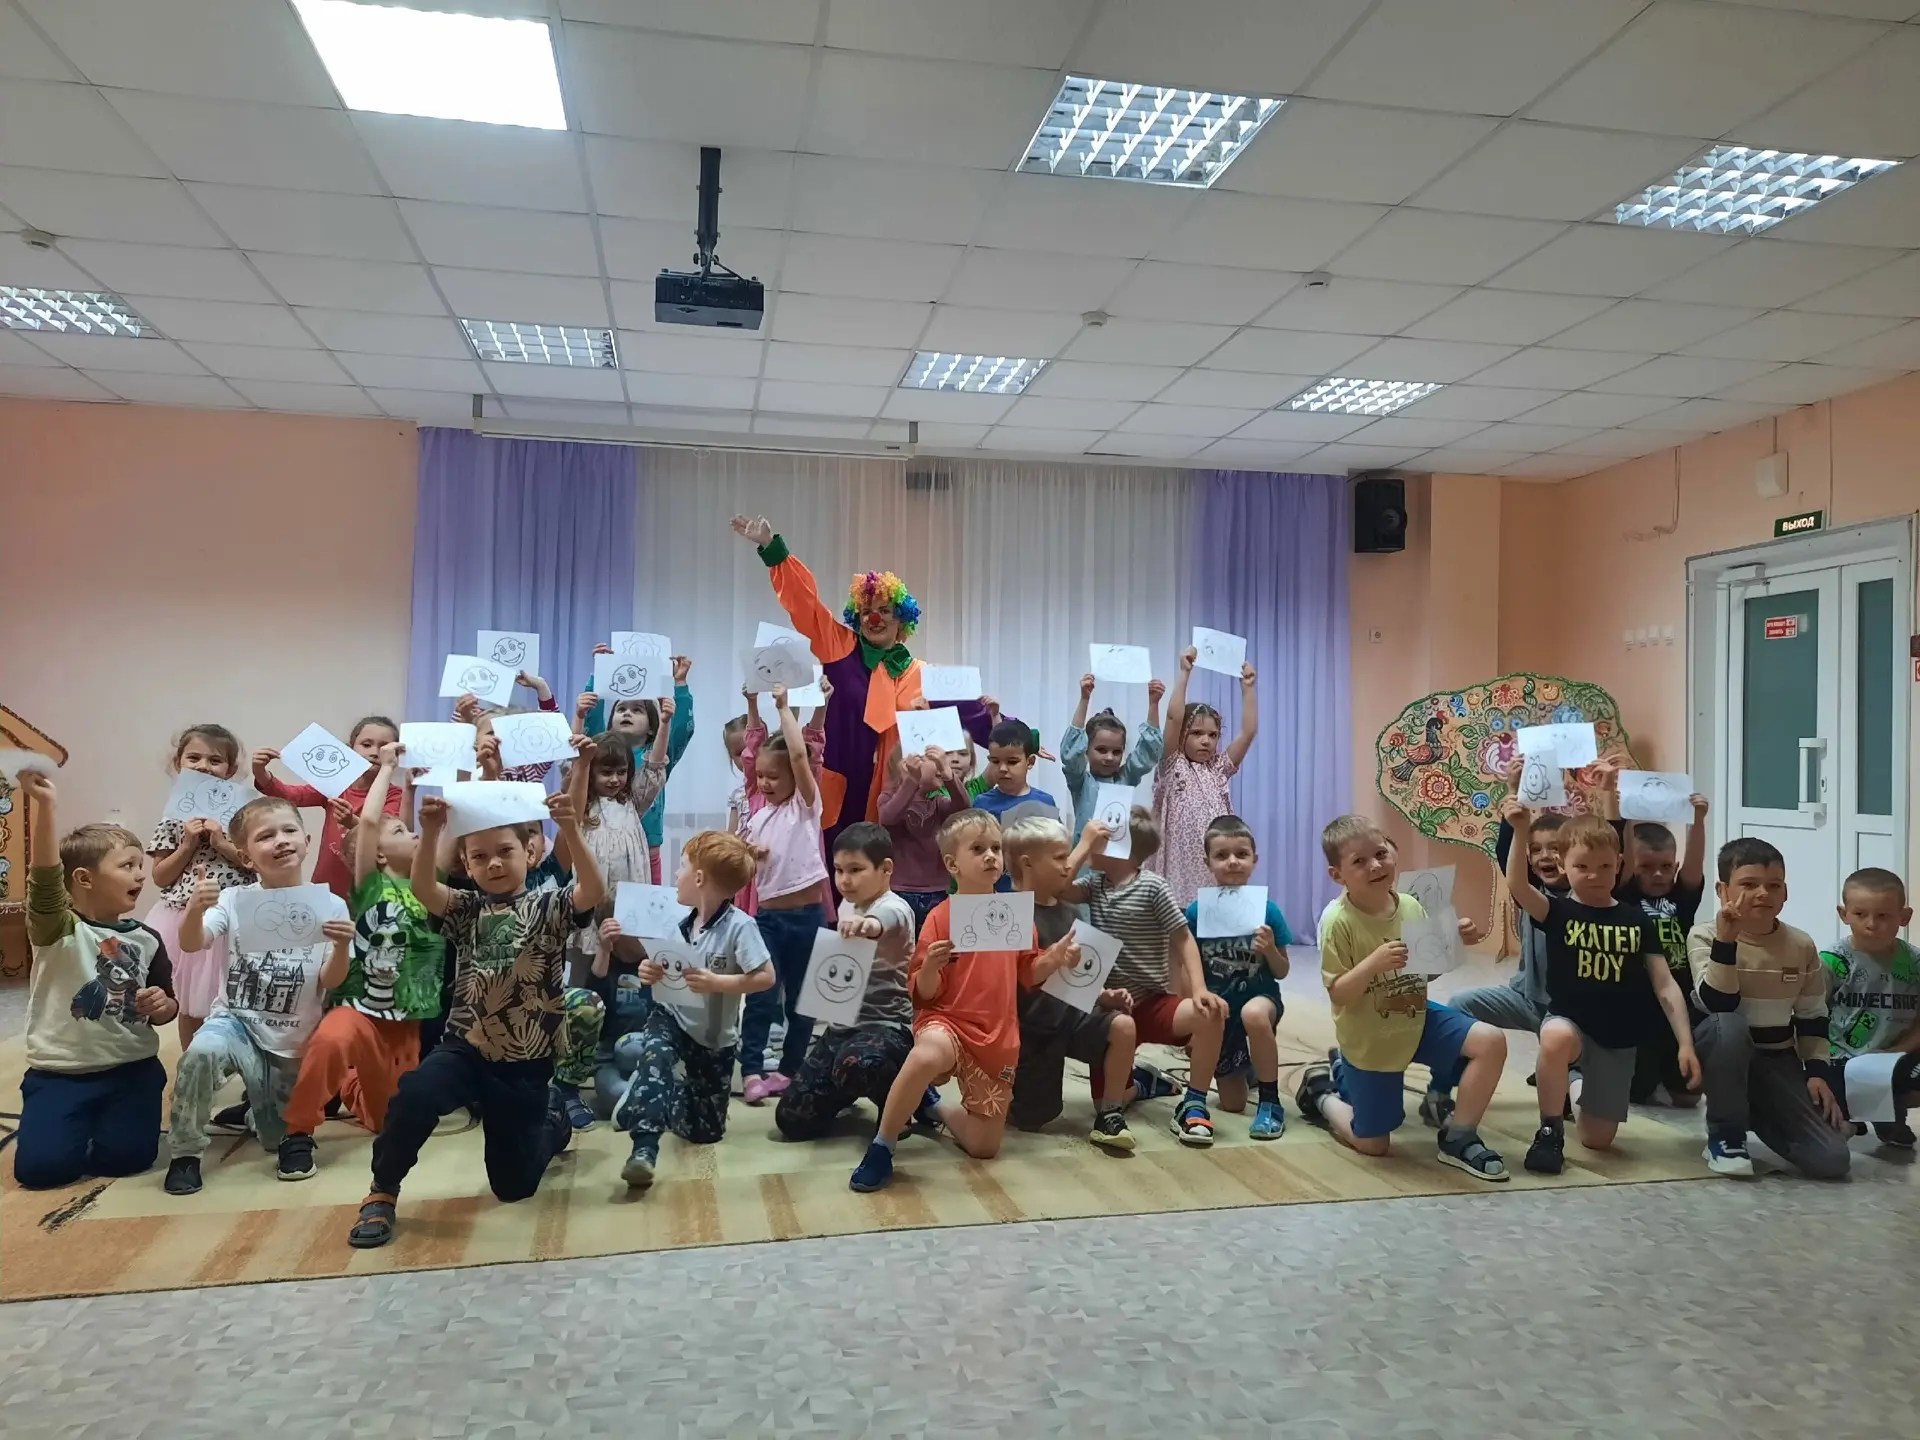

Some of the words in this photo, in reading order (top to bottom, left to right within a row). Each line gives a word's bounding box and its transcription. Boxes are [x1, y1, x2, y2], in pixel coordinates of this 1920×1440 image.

[1782, 516, 1815, 531] ВЫХОД
[1564, 919, 1641, 953] SKATER
[1201, 937, 1256, 956] ROA
[1577, 949, 1625, 982] BOY
[1838, 992, 1919, 1010] MINECRAF
